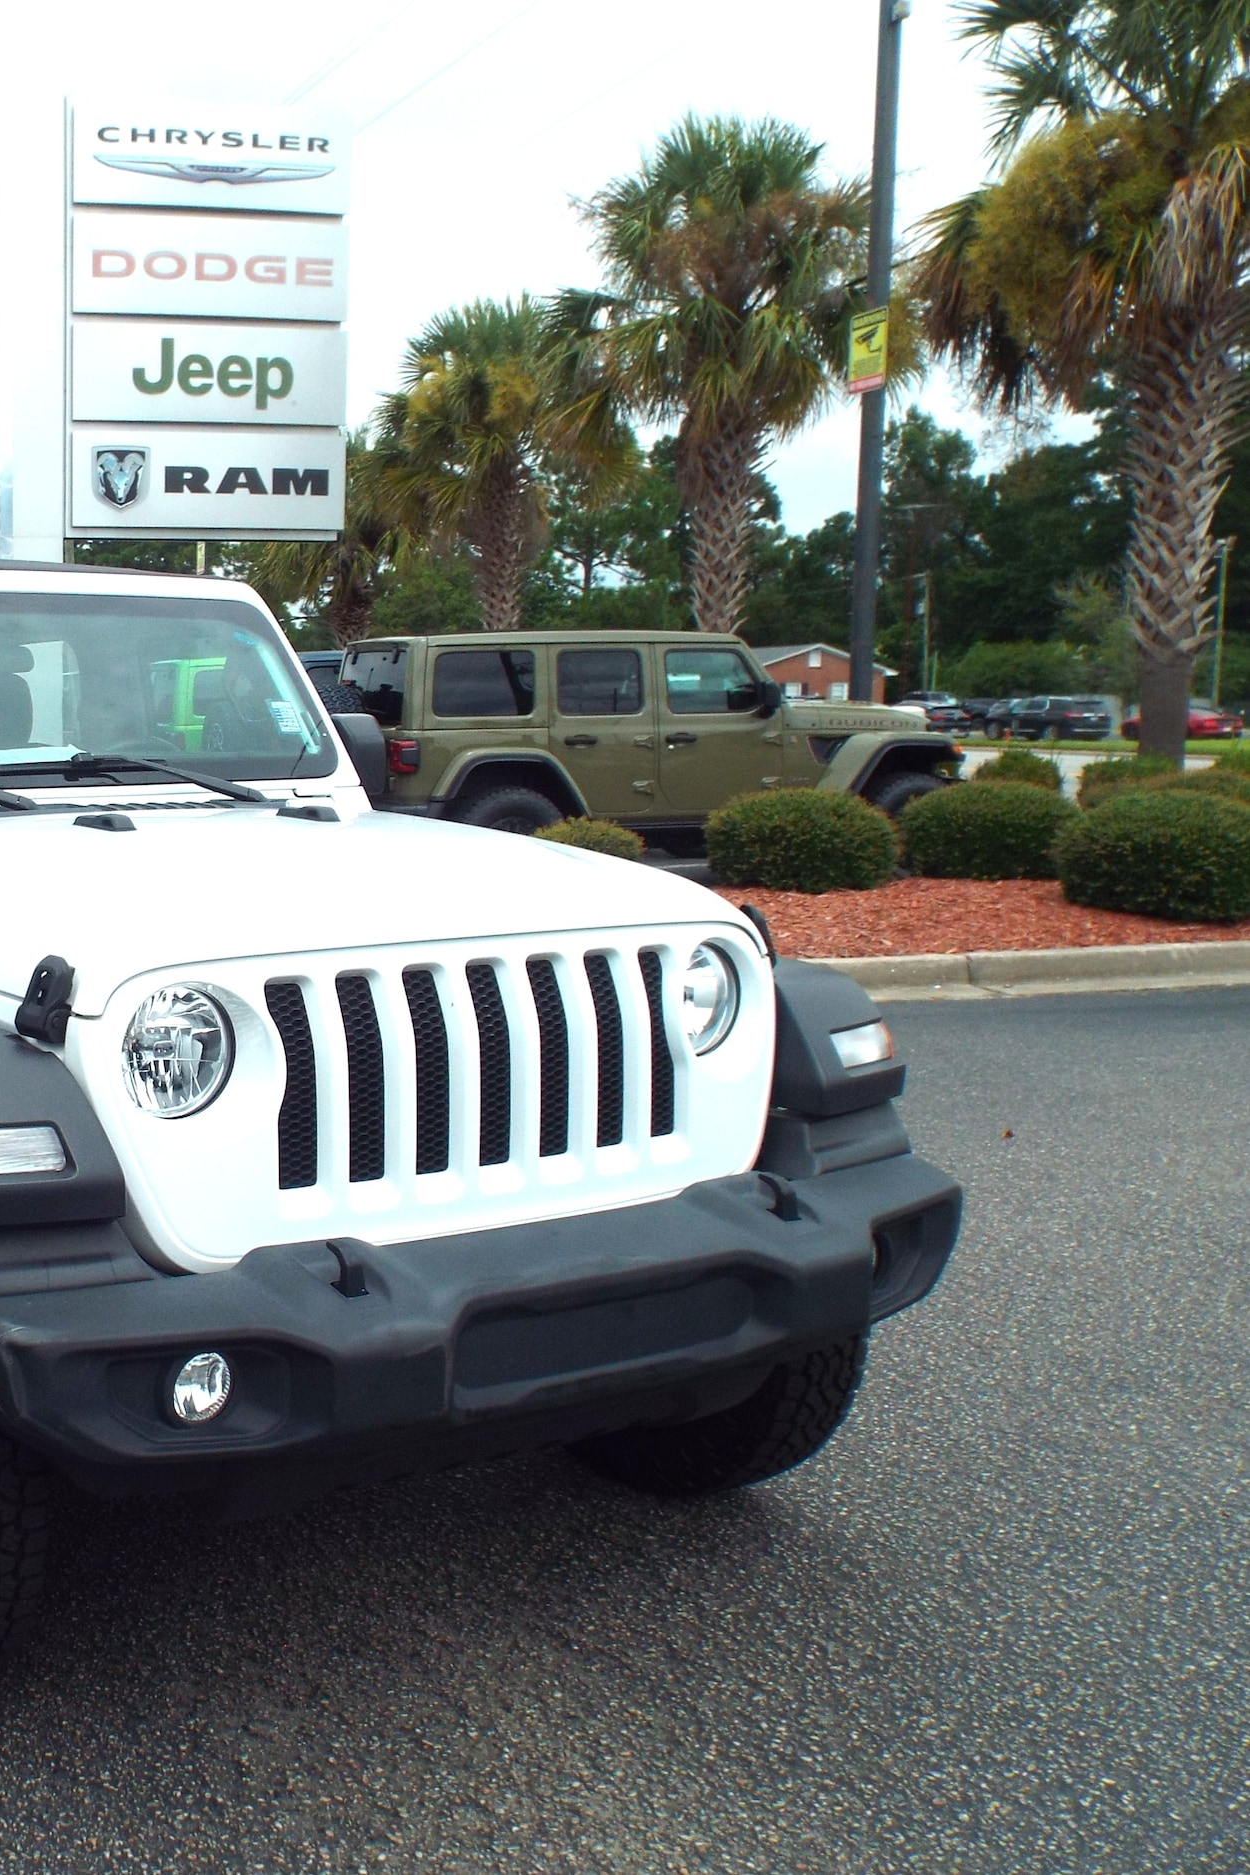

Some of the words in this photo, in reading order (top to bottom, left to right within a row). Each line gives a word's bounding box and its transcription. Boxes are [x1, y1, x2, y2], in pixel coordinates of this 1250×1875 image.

[97, 127, 331, 153] CHRYSLER
[91, 249, 335, 287] DODGE
[132, 338, 294, 410] Jeep
[164, 466, 330, 496] RAM
